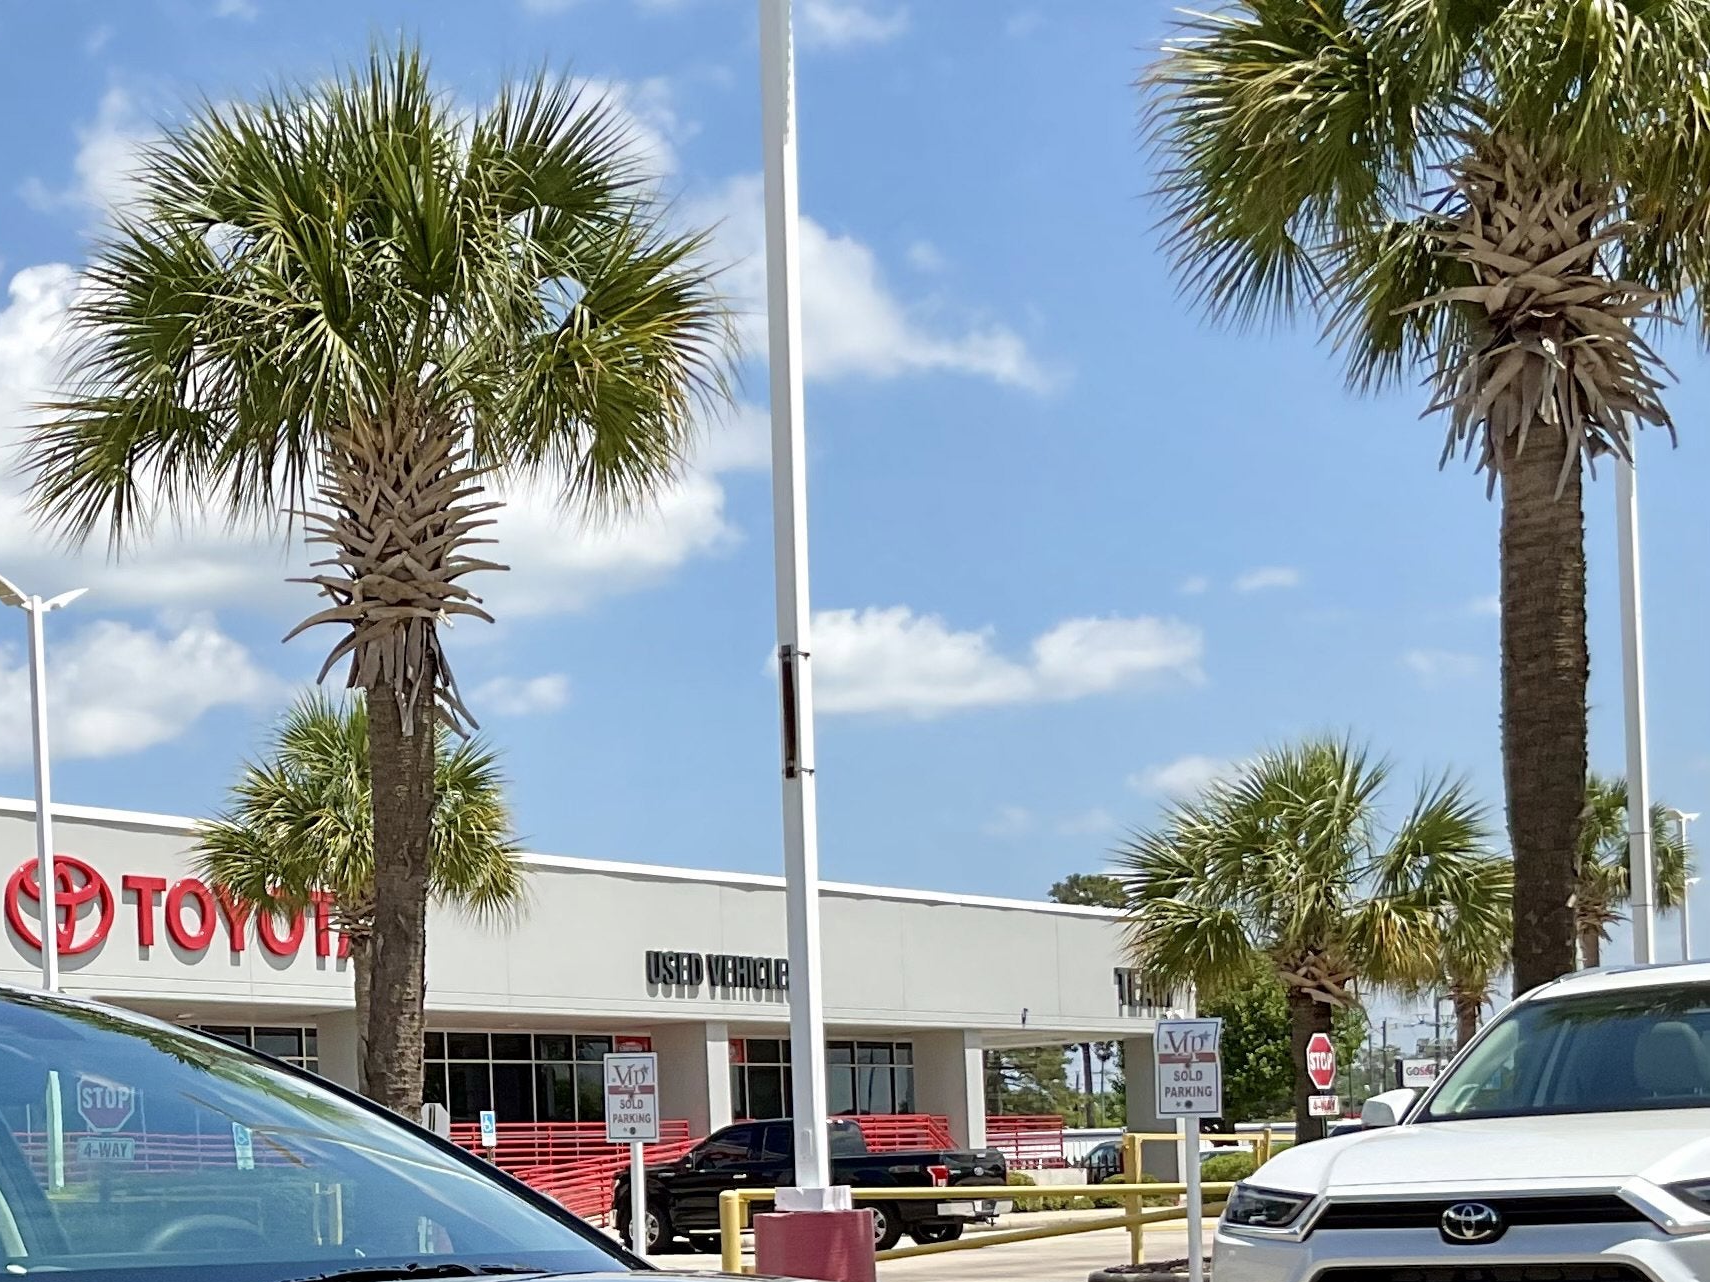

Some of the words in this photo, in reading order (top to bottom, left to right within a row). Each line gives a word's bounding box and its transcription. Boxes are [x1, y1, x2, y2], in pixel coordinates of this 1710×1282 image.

[646, 950, 703, 986] USED
[705, 953, 789, 991] VEHICLE
[1309, 1052, 1333, 1071] STOP
[1173, 1070, 1203, 1082] SOLD
[81, 1087, 129, 1109] STOP
[1164, 1086, 1213, 1098] PARKING
[620, 1099, 644, 1110] SOLD
[612, 1113, 652, 1124] PARKING
[83, 1142, 128, 1158] 4-WAY
